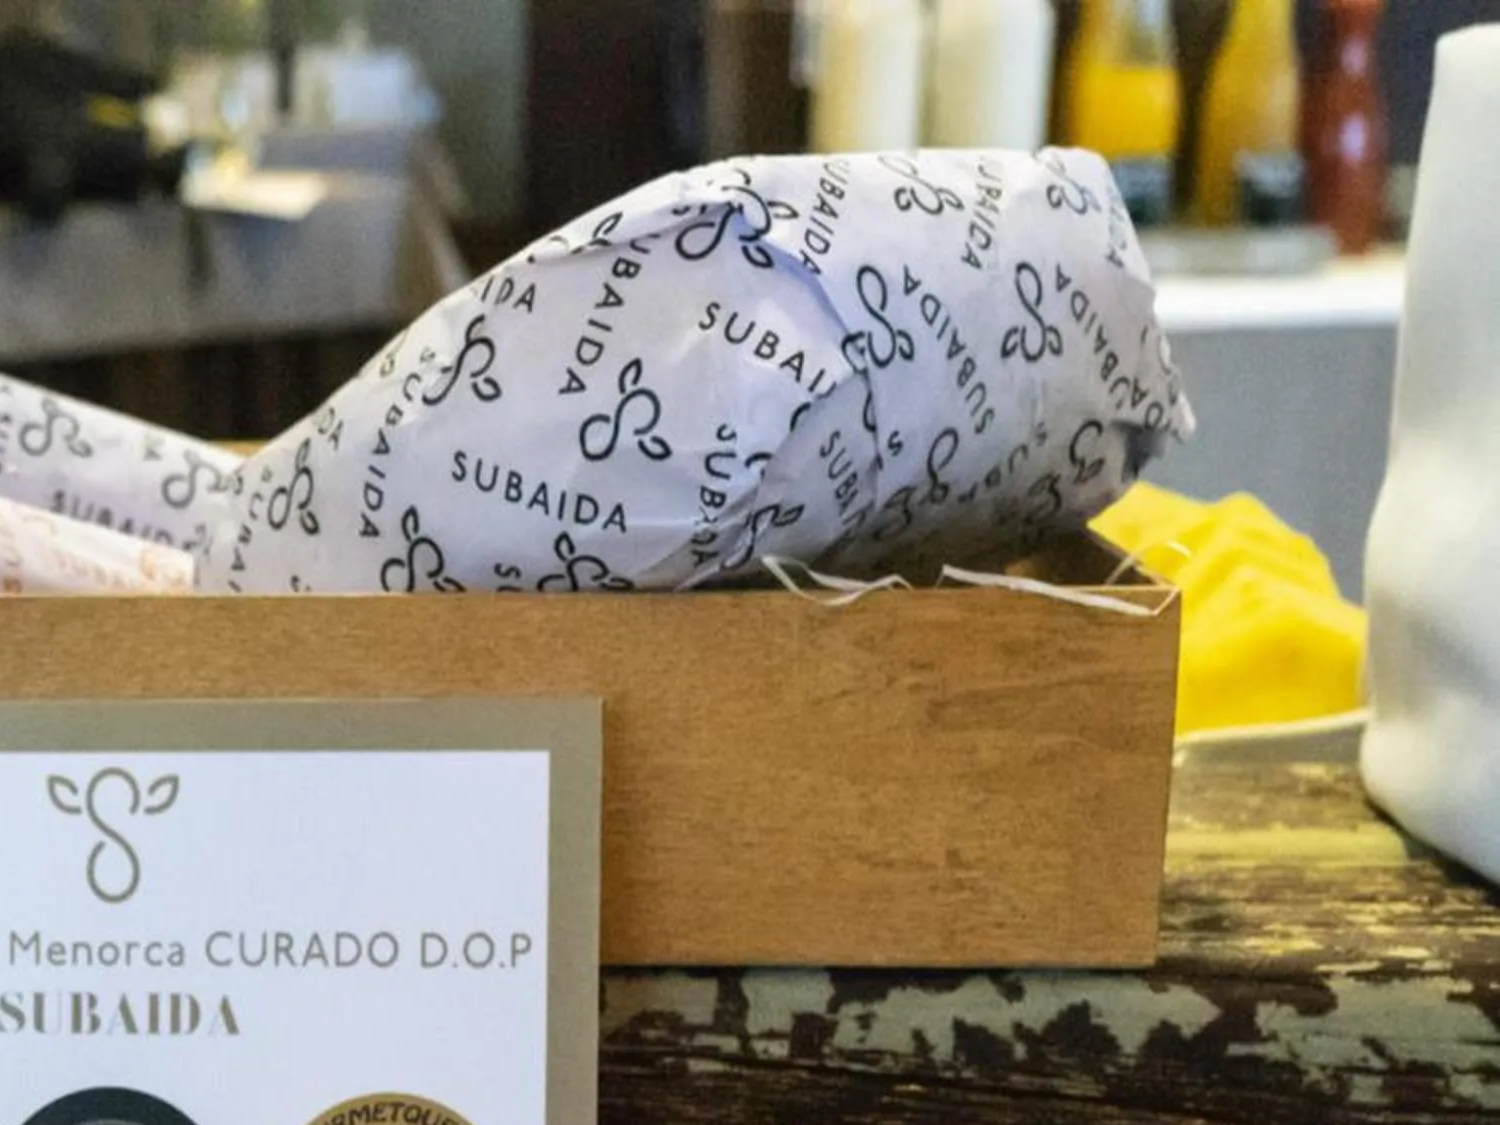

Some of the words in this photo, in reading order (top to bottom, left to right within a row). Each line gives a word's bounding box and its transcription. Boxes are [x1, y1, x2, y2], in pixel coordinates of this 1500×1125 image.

[902, 264, 995, 435] SUBAIDA
[451, 451, 627, 533] SUBAIDA
[9, 930, 186, 967] Menorca
[205, 931, 400, 968] CURADO
[420, 931, 532, 969] D.O.P
